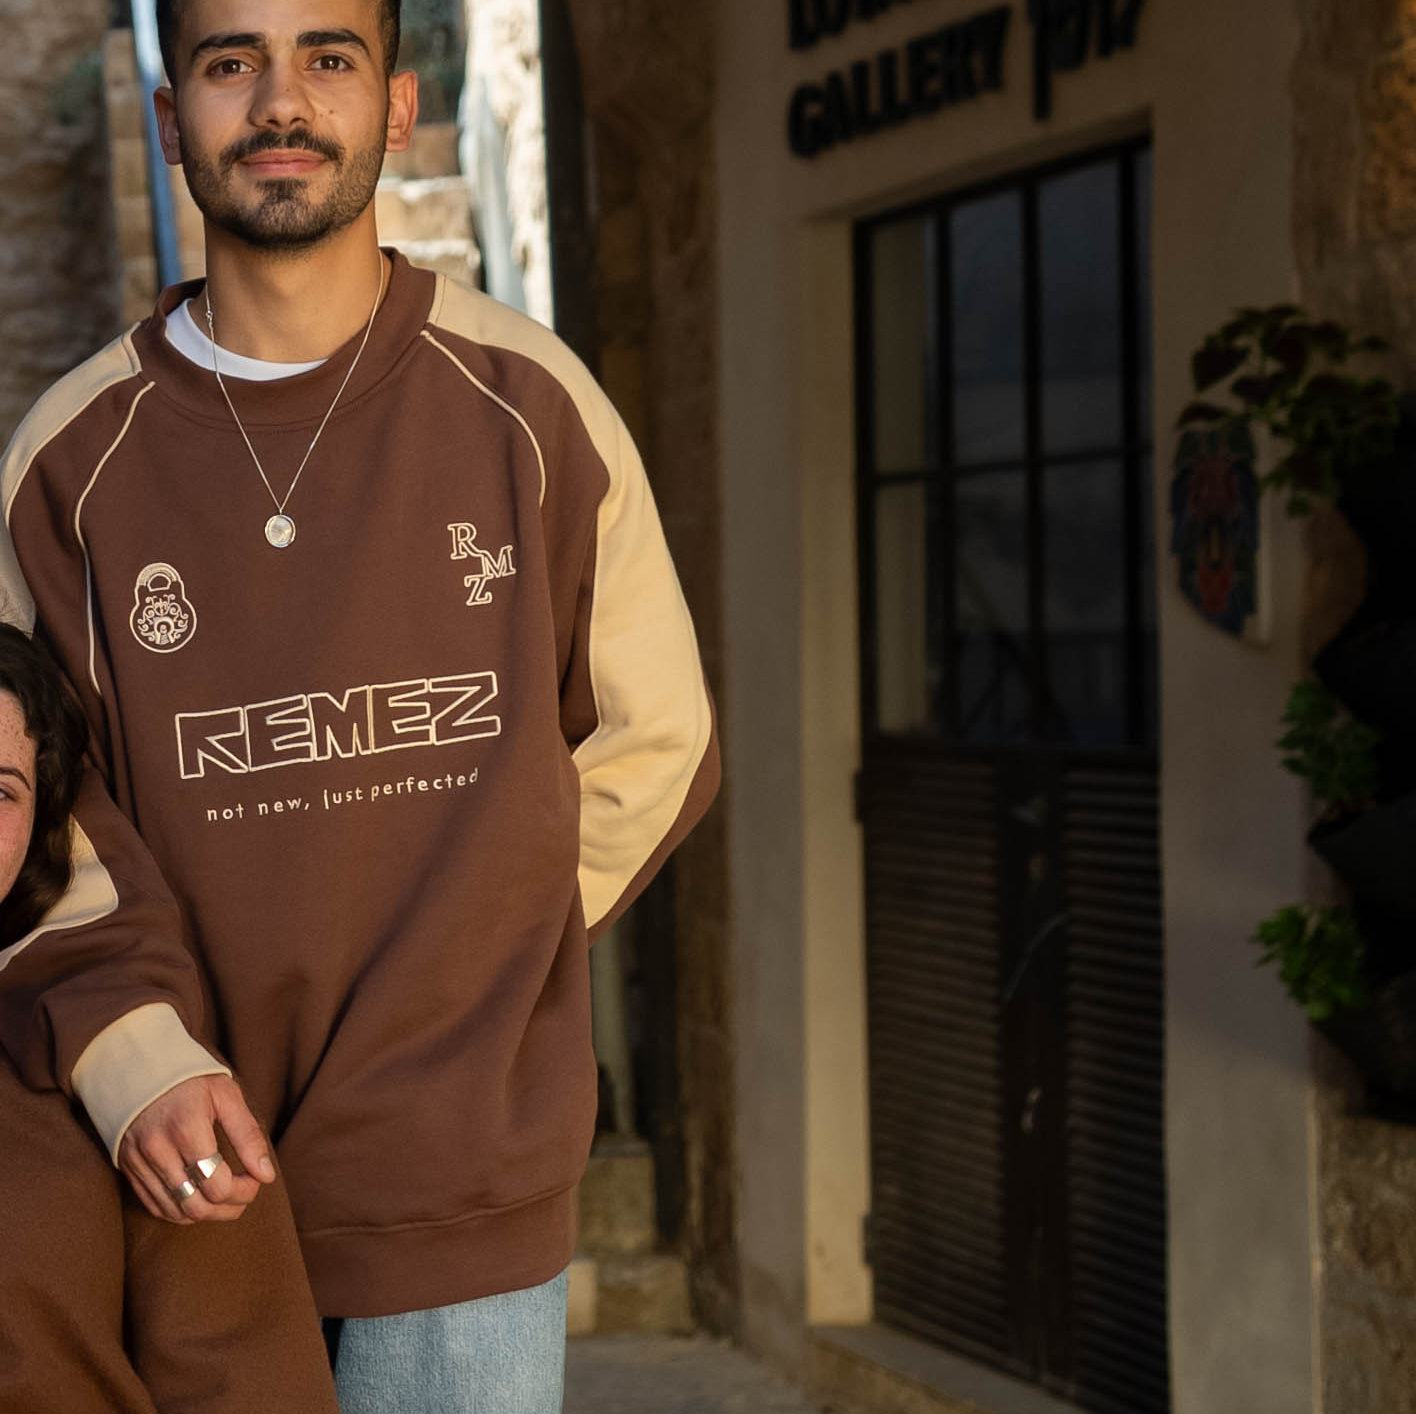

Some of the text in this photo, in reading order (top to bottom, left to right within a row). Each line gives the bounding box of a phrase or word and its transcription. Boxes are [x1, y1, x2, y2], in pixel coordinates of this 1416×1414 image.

[789, 5, 1011, 159] GALLERY
[174, 670, 502, 780] REMEZ
[206, 767, 479, 822] not new, just perfected
